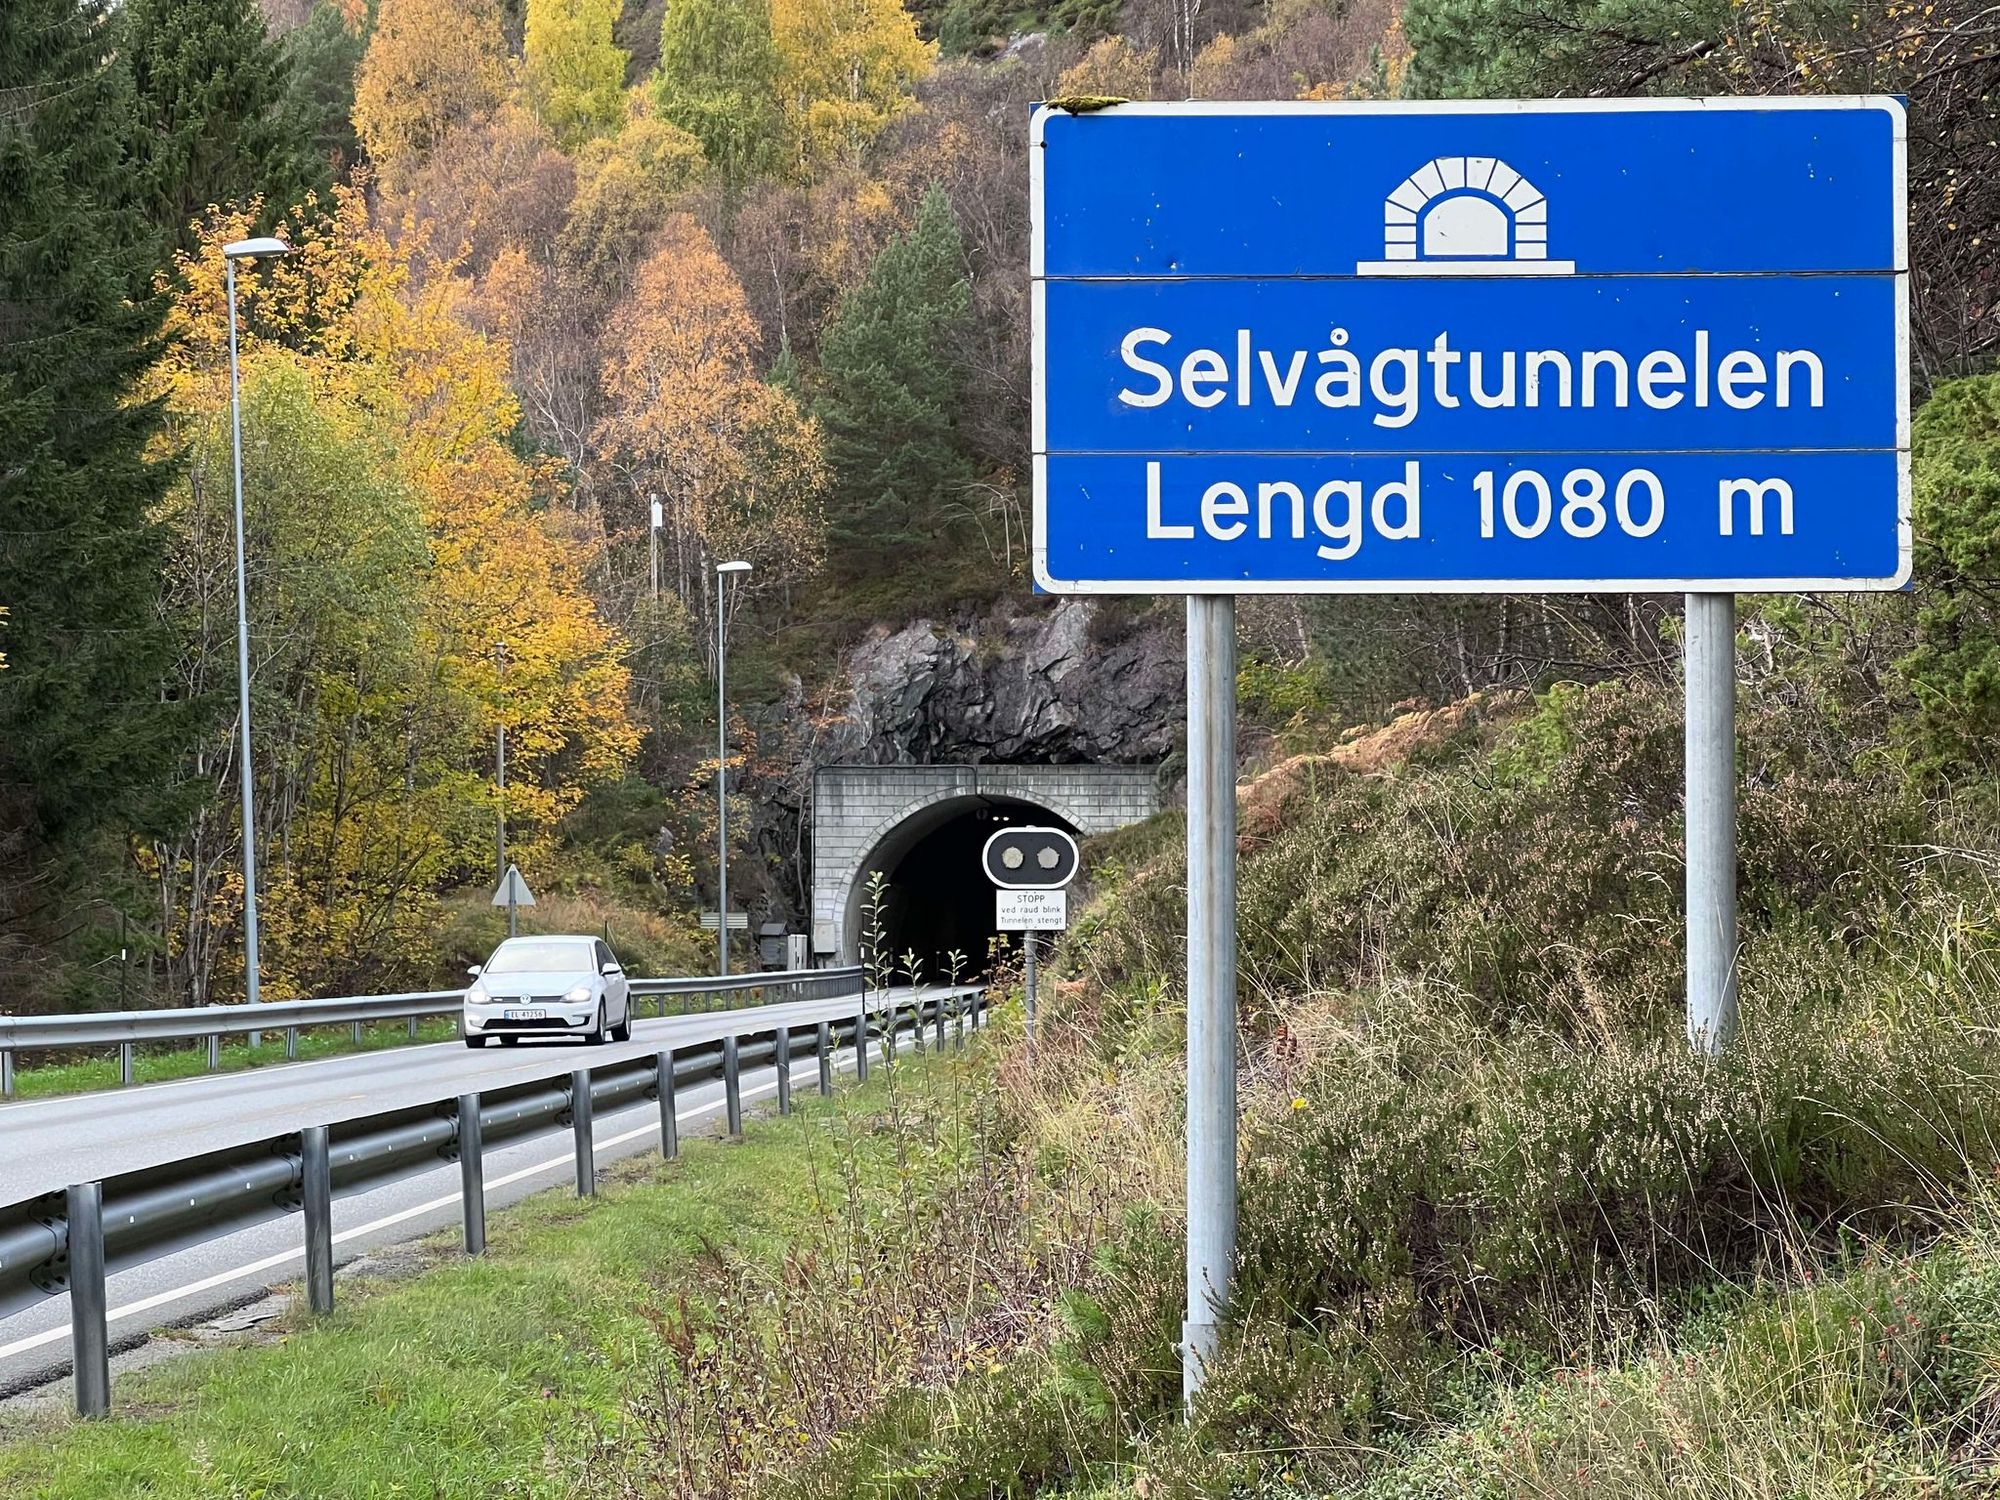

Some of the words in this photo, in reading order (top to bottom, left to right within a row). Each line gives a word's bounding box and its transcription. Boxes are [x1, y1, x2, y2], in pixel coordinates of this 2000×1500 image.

[1117, 327, 1824, 428] Selvågtunnelen
[1146, 460, 1420, 561] Lengd
[1473, 468, 1665, 539] 1080
[1719, 478, 1794, 536] m
[1017, 895, 1046, 903] STOPP
[1001, 906, 1016, 914] ved
[1020, 906, 1039, 914] raud
[1042, 906, 1062, 914] blink
[1037, 917, 1062, 925] stengt
